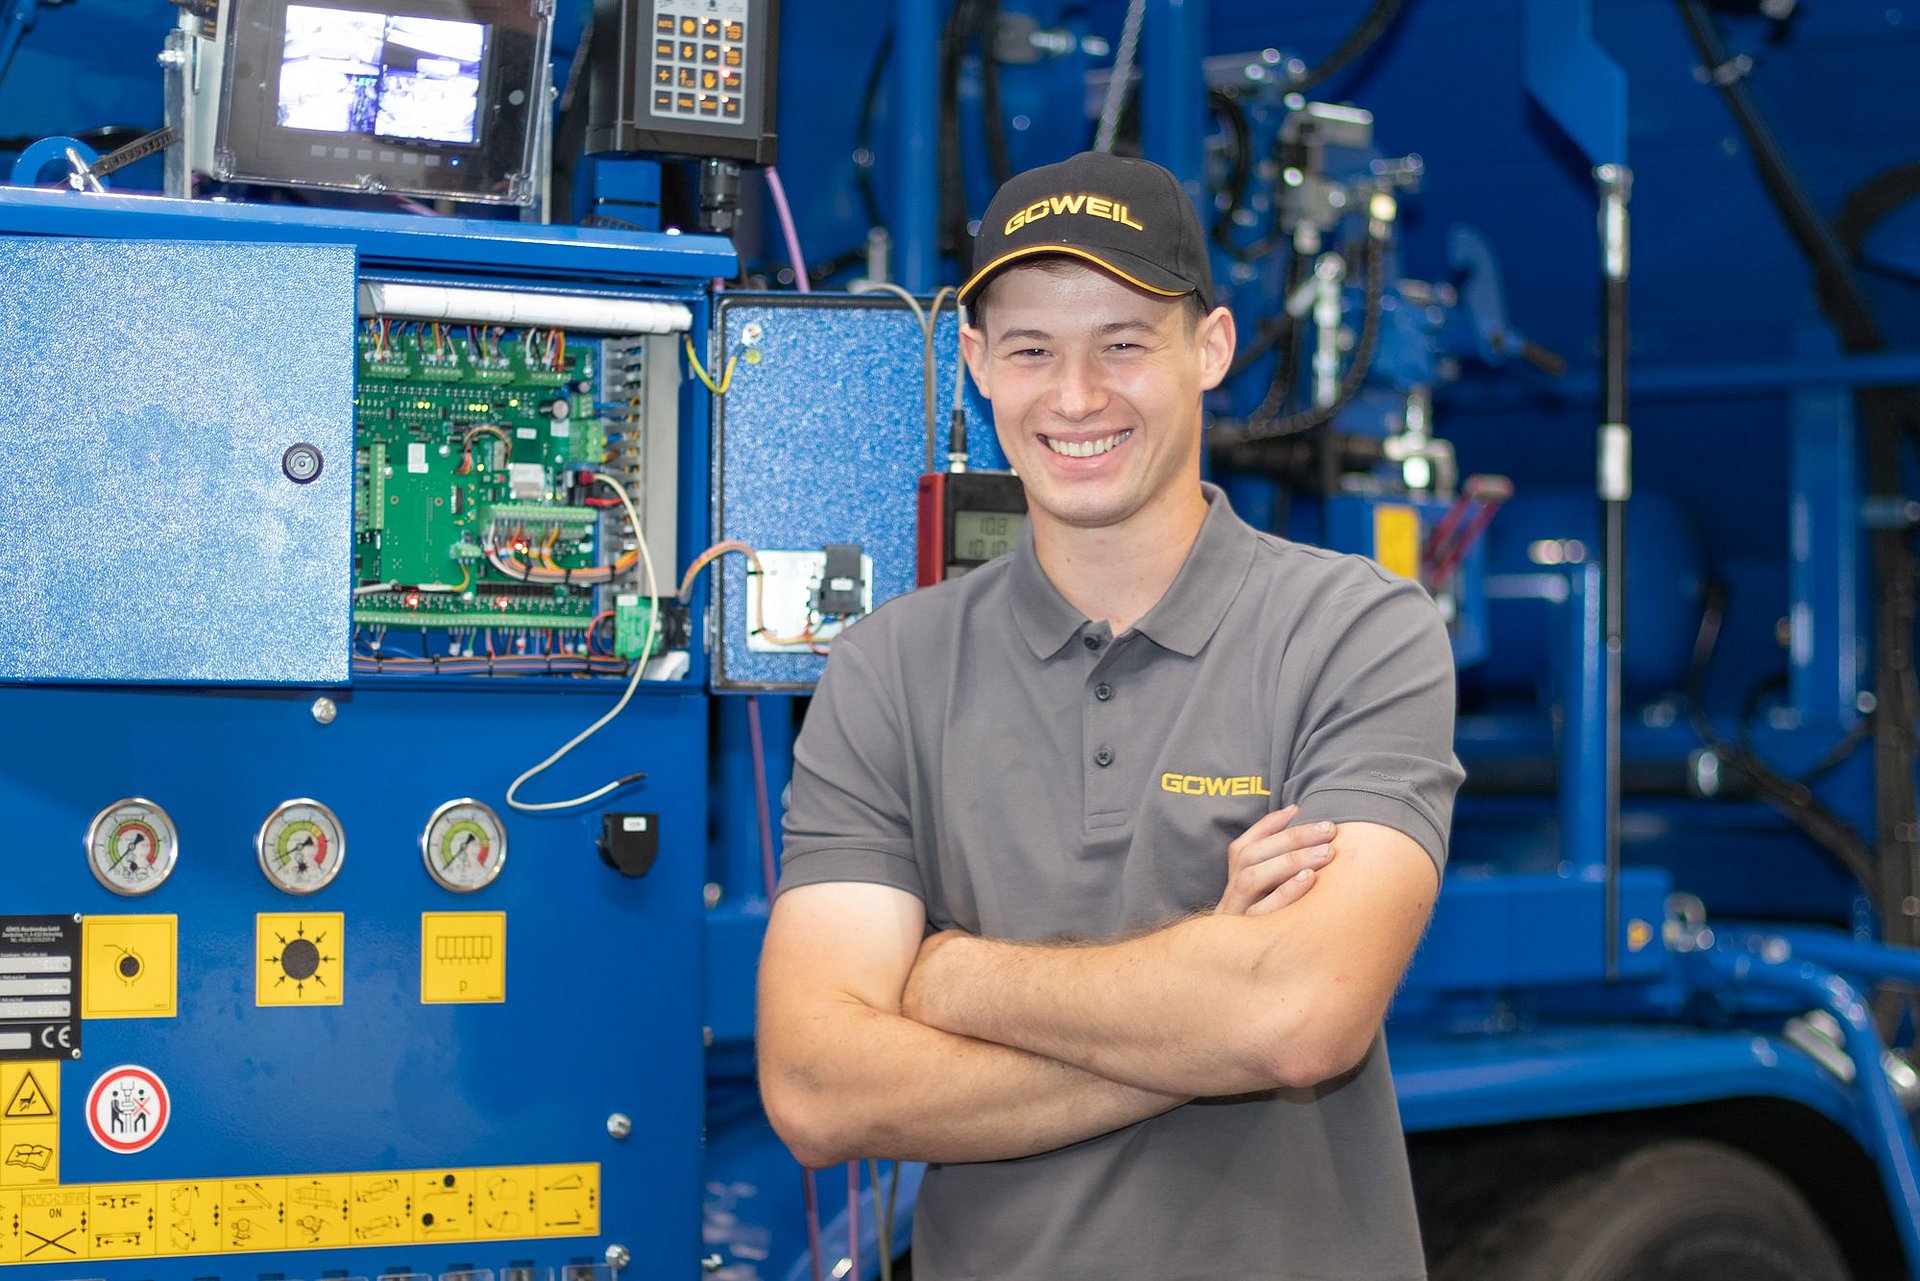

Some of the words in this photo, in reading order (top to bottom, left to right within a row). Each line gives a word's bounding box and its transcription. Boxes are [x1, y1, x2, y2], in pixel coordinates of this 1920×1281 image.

[1004, 195, 1144, 236] GOWEIL
[1161, 772, 1271, 797] GOWEIL
[49, 1208, 62, 1218] ON
